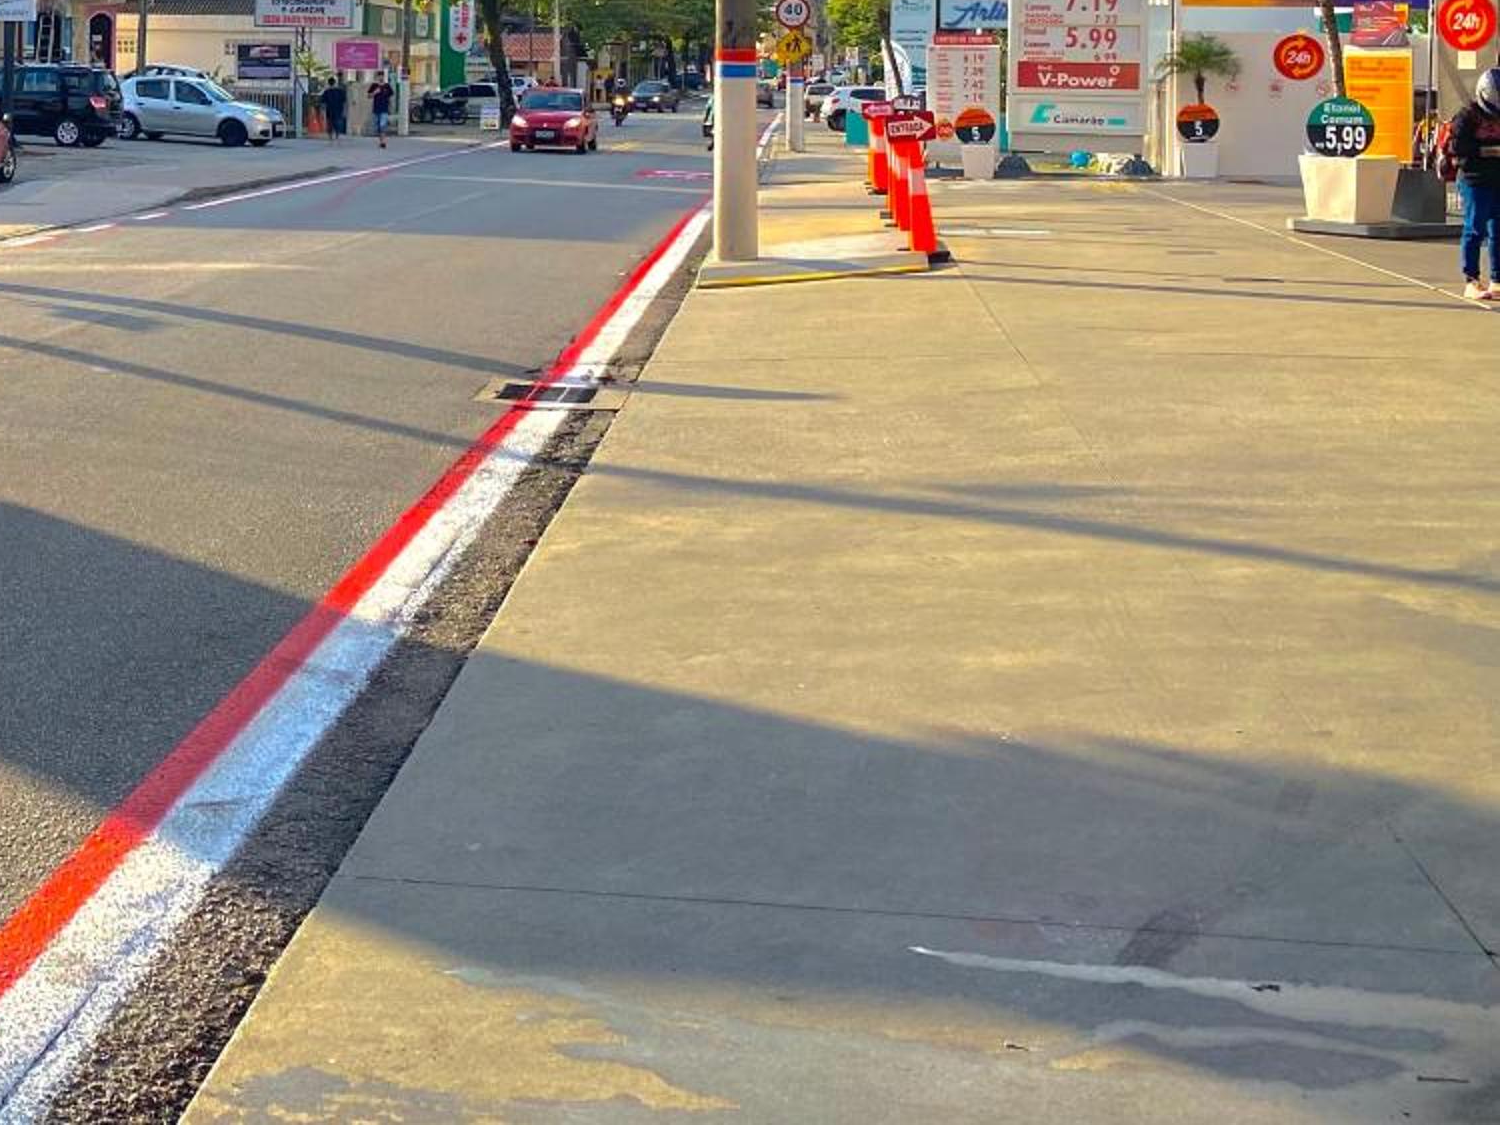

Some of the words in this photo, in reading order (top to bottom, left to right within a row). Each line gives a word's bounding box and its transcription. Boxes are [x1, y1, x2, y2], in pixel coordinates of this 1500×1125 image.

[784, 3, 803, 16] 40
[1452, 12, 1481, 30] 24h
[1065, 27, 1118, 49] 5.99
[1285, 50, 1311, 64] 24h
[1037, 72, 1116, 87] V-Power
[1320, 114, 1363, 124] Comum
[1325, 125, 1367, 155] 5,99
